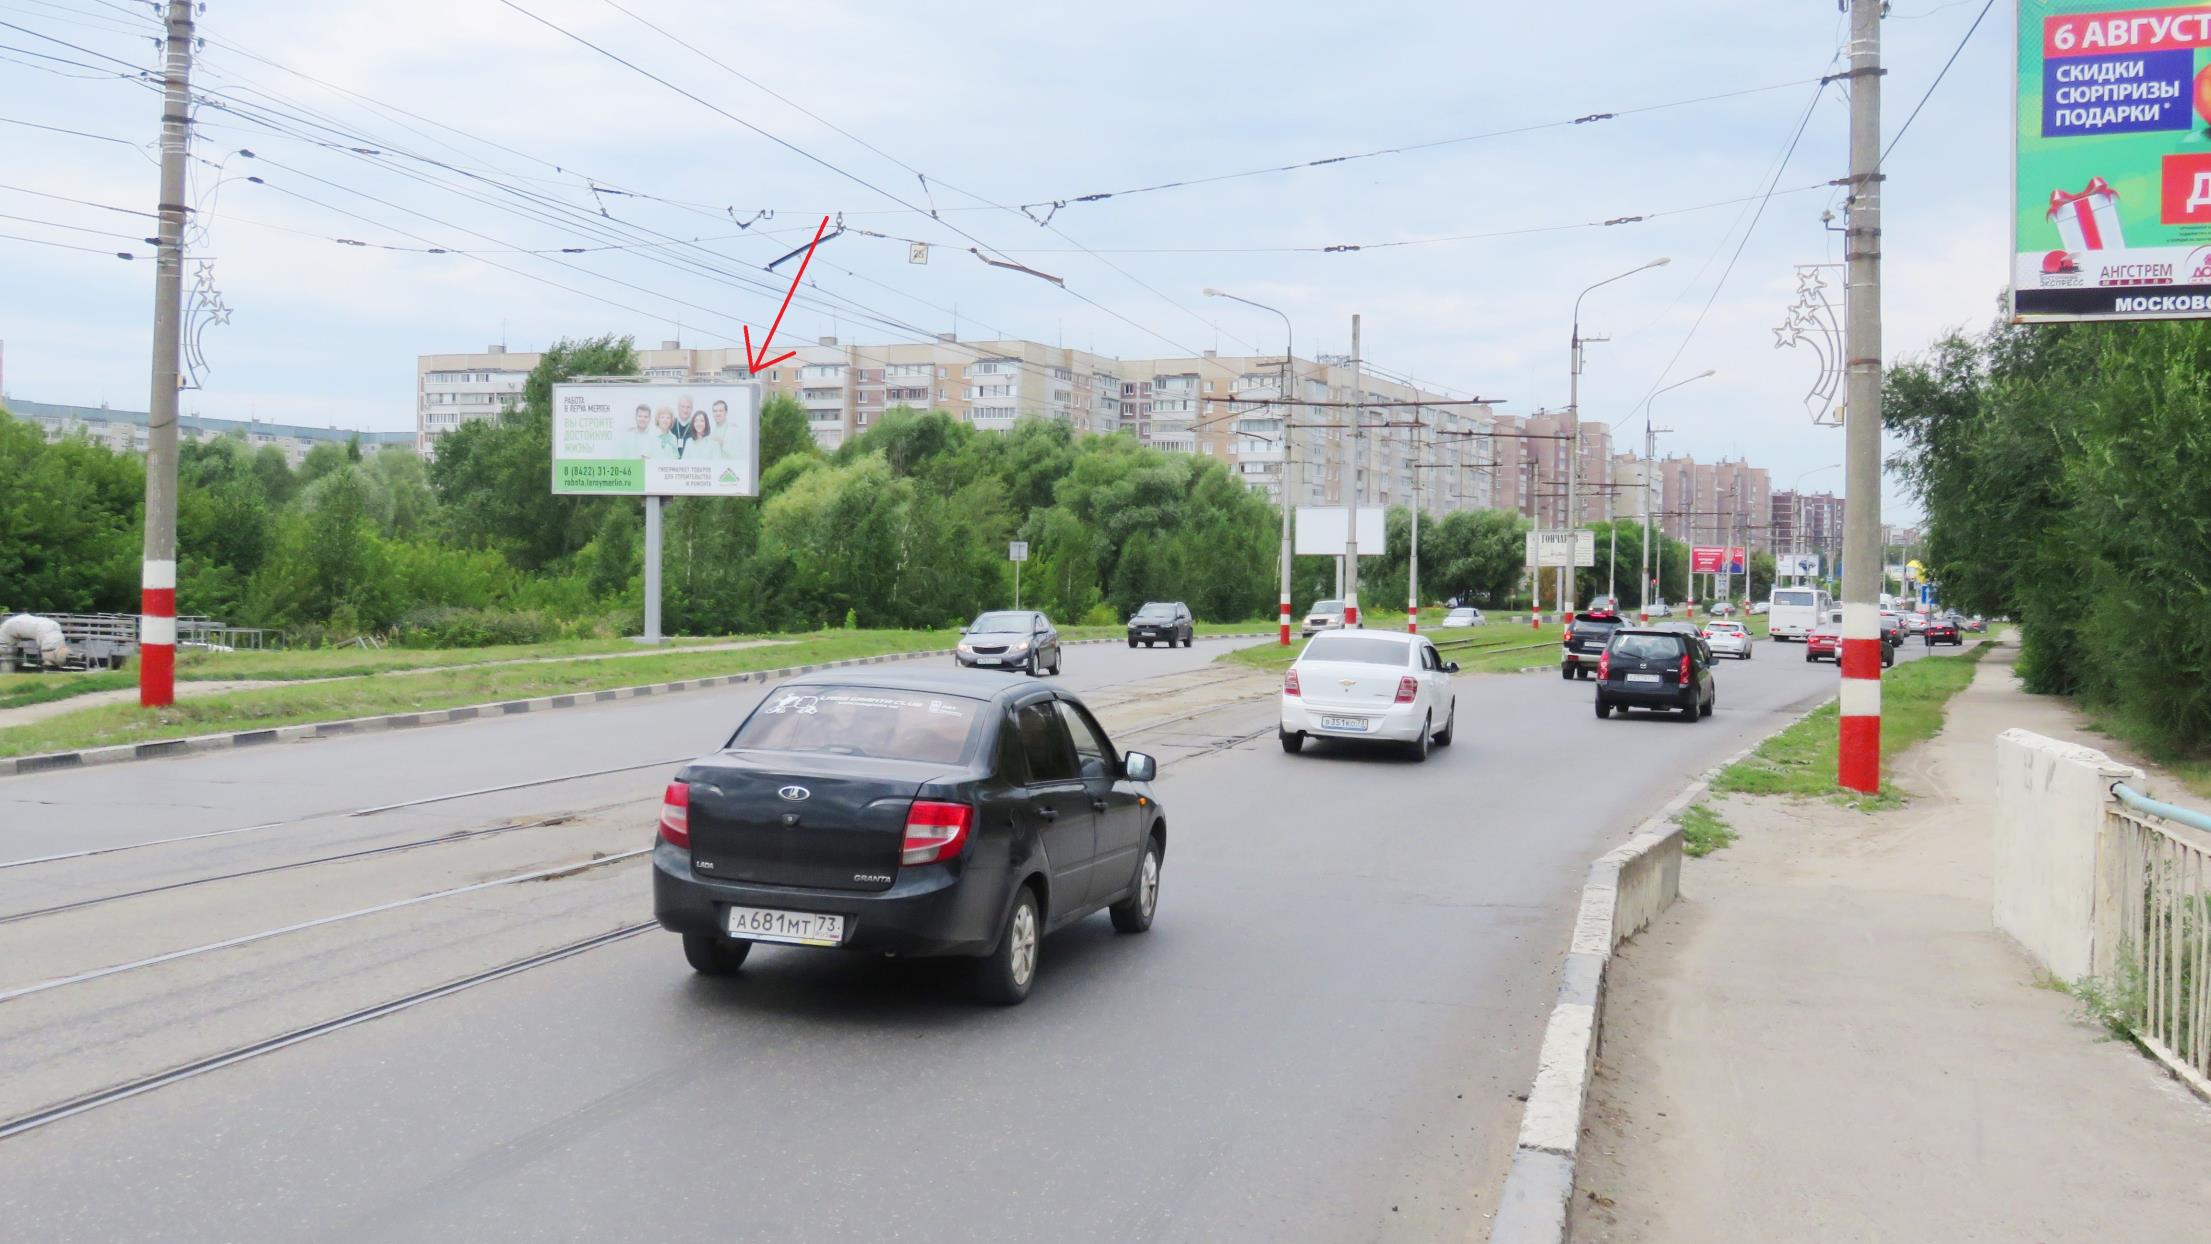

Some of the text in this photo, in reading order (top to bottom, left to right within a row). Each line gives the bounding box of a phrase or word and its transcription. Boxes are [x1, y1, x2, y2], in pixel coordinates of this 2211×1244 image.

[2054, 13, 2211, 49] 6 АВГУСТ
[2055, 60, 2145, 84] СКИДКИ
[2055, 80, 2180, 105] СЮРПРИЗЫ
[2100, 263, 2173, 278] АНГСТРЕМ
[571, 466, 595, 477] (8422)
[597, 466, 632, 477] 31-20-46
[696, 861, 714, 869] LADA
[854, 874, 892, 883] GRANTA
[818, 916, 836, 931] 73
